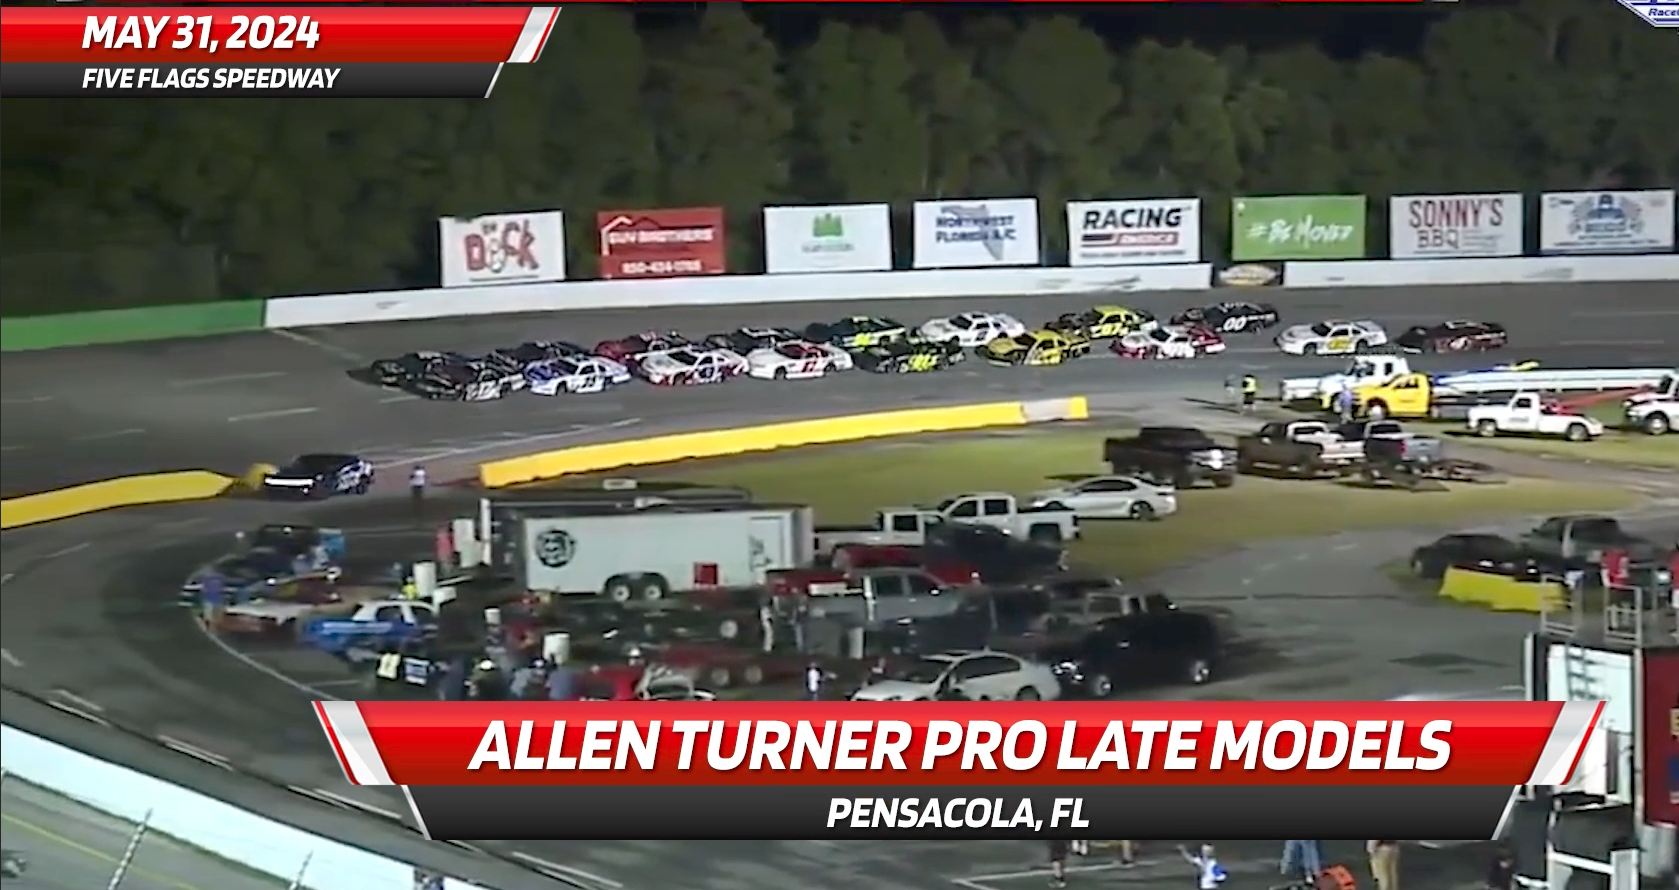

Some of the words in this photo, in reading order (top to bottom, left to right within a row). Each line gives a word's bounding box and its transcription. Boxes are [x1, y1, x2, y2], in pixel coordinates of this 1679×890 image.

[1082, 208, 1183, 229] RACING
[1408, 198, 1504, 228] SONNY'S
[1417, 229, 1460, 249] BBQ
[1223, 316, 1248, 331] 00
